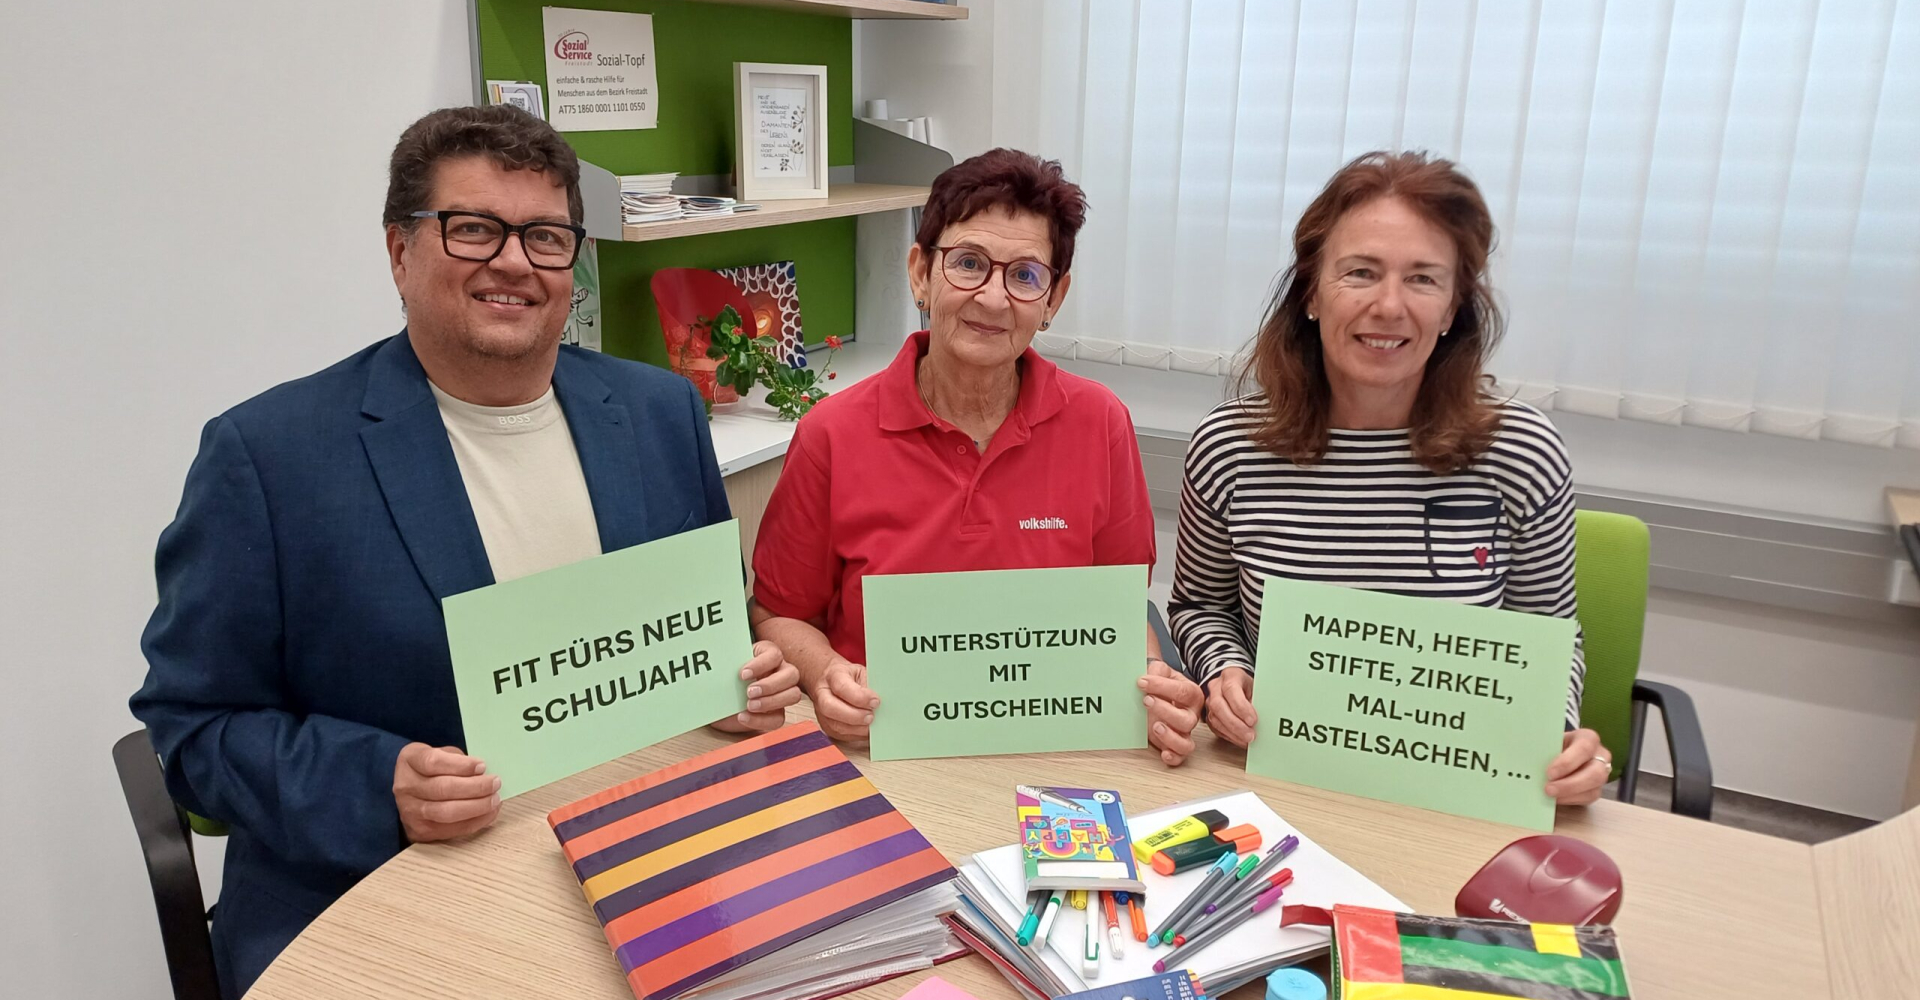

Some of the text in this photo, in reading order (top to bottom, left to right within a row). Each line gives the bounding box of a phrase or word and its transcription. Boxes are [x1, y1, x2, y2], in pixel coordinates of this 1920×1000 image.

[562, 39, 587, 51] Sozial
[562, 49, 593, 60] Service
[597, 54, 645, 68] Sozial-Topf
[556, 76, 579, 84] einfache
[580, 76, 585, 84] &
[604, 75, 616, 83] Hilfe
[617, 75, 625, 83] für
[557, 89, 585, 97] Menschen
[596, 88, 608, 96] dem
[609, 88, 625, 96] Bezirk
[626, 87, 648, 95] Freistadt
[558, 102, 645, 114] AT75 1860 0001 1101 0550
[498, 414, 531, 425] BOSS
[1019, 517, 1068, 530] volkshilfe.
[492, 600, 723, 694] FIT FÜRS NEUE
[901, 626, 1117, 654] UNTERSTÜTZUNG
[1303, 613, 1528, 670] MAPPEN, HEFTE,
[989, 663, 1031, 683] MIT
[1308, 651, 1513, 704] STIFTE, ZIRKEL,
[522, 649, 712, 732] SCHULJAHR
[923, 696, 1102, 721] GUTSCHEINEN
[1347, 693, 1466, 730] MAL-und
[1278, 718, 1498, 778] BASTELSACHEN,
[1027, 830, 1103, 844] HAPPY
